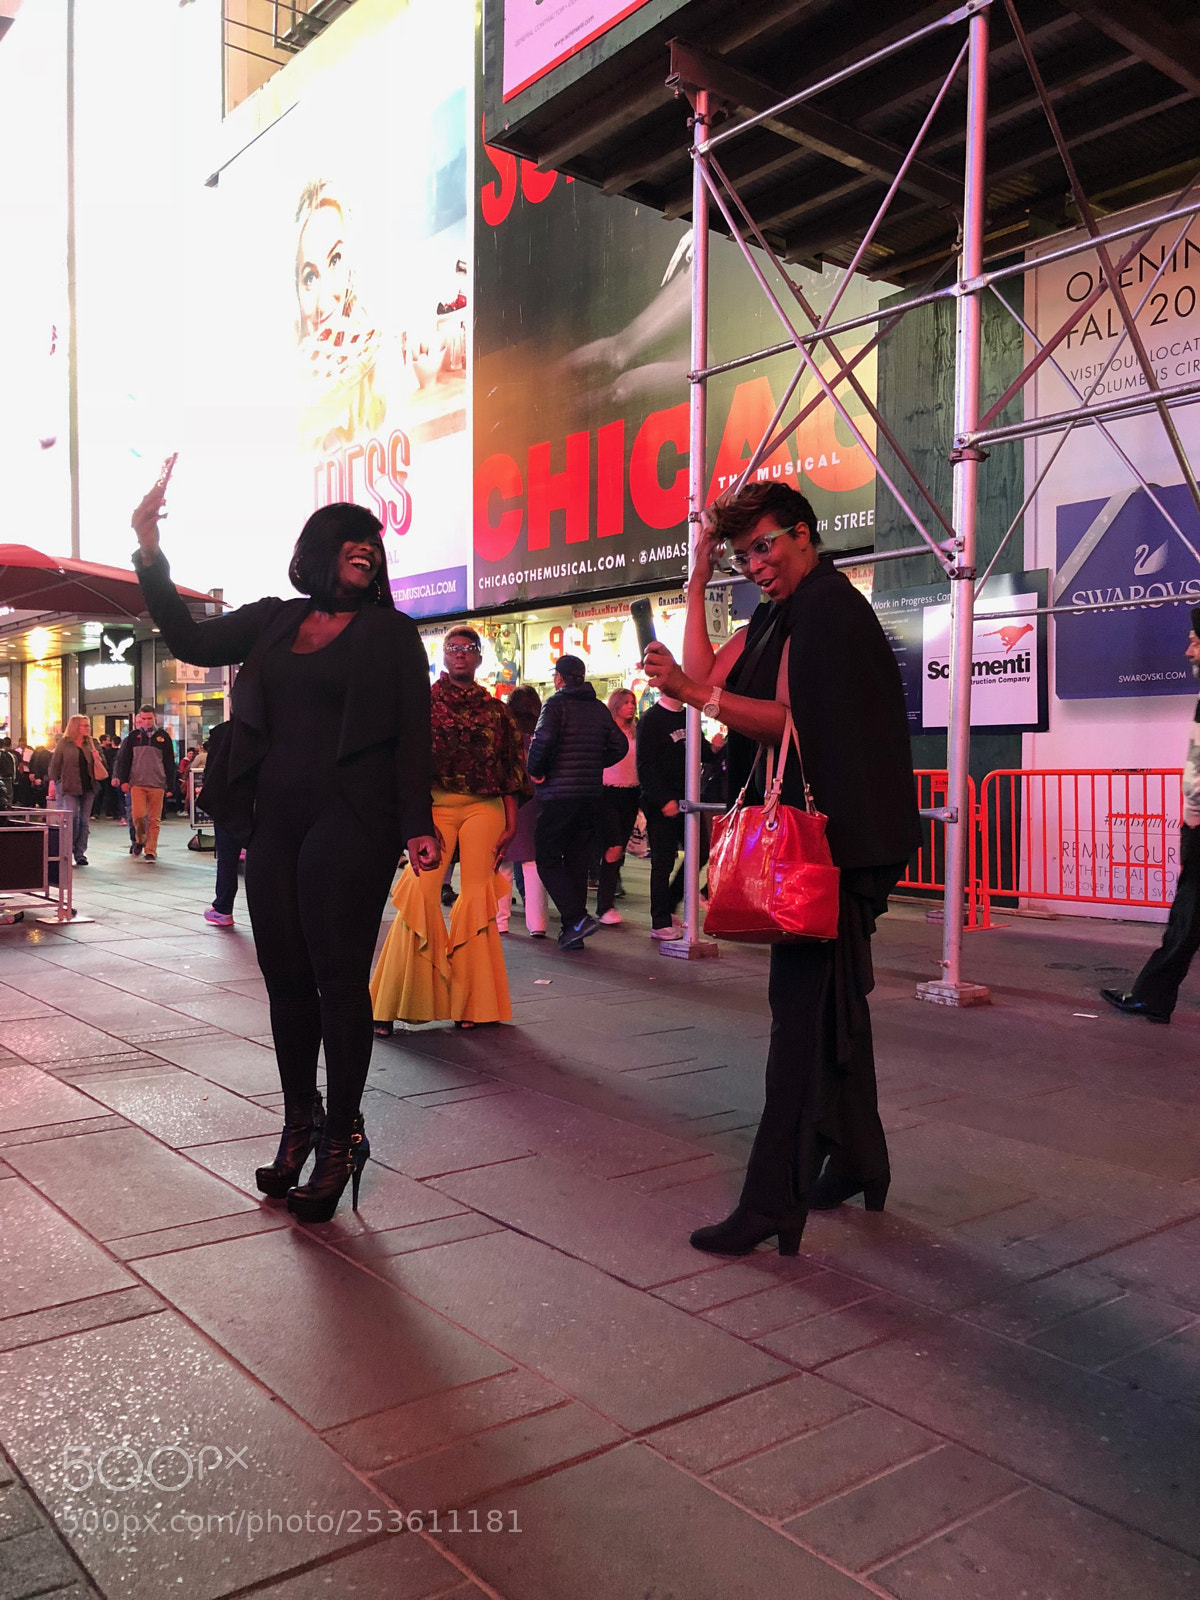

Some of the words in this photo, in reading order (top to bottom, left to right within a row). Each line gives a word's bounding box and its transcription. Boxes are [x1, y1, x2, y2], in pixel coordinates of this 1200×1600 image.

[1070, 362, 1105, 382] VISIT
[756, 451, 841, 482] MUSICAL
[478, 553, 626, 589] CHICAGOTHEMUSICAL.COM
[871, 599, 891, 610] Work
[892, 597, 900, 607] in
[927, 651, 1031, 680] Scmenti
[998, 675, 1031, 684] Company
[1118, 671, 1187, 683] SWAROVSKI.COM
[1062, 841, 1115, 860] REMIX
